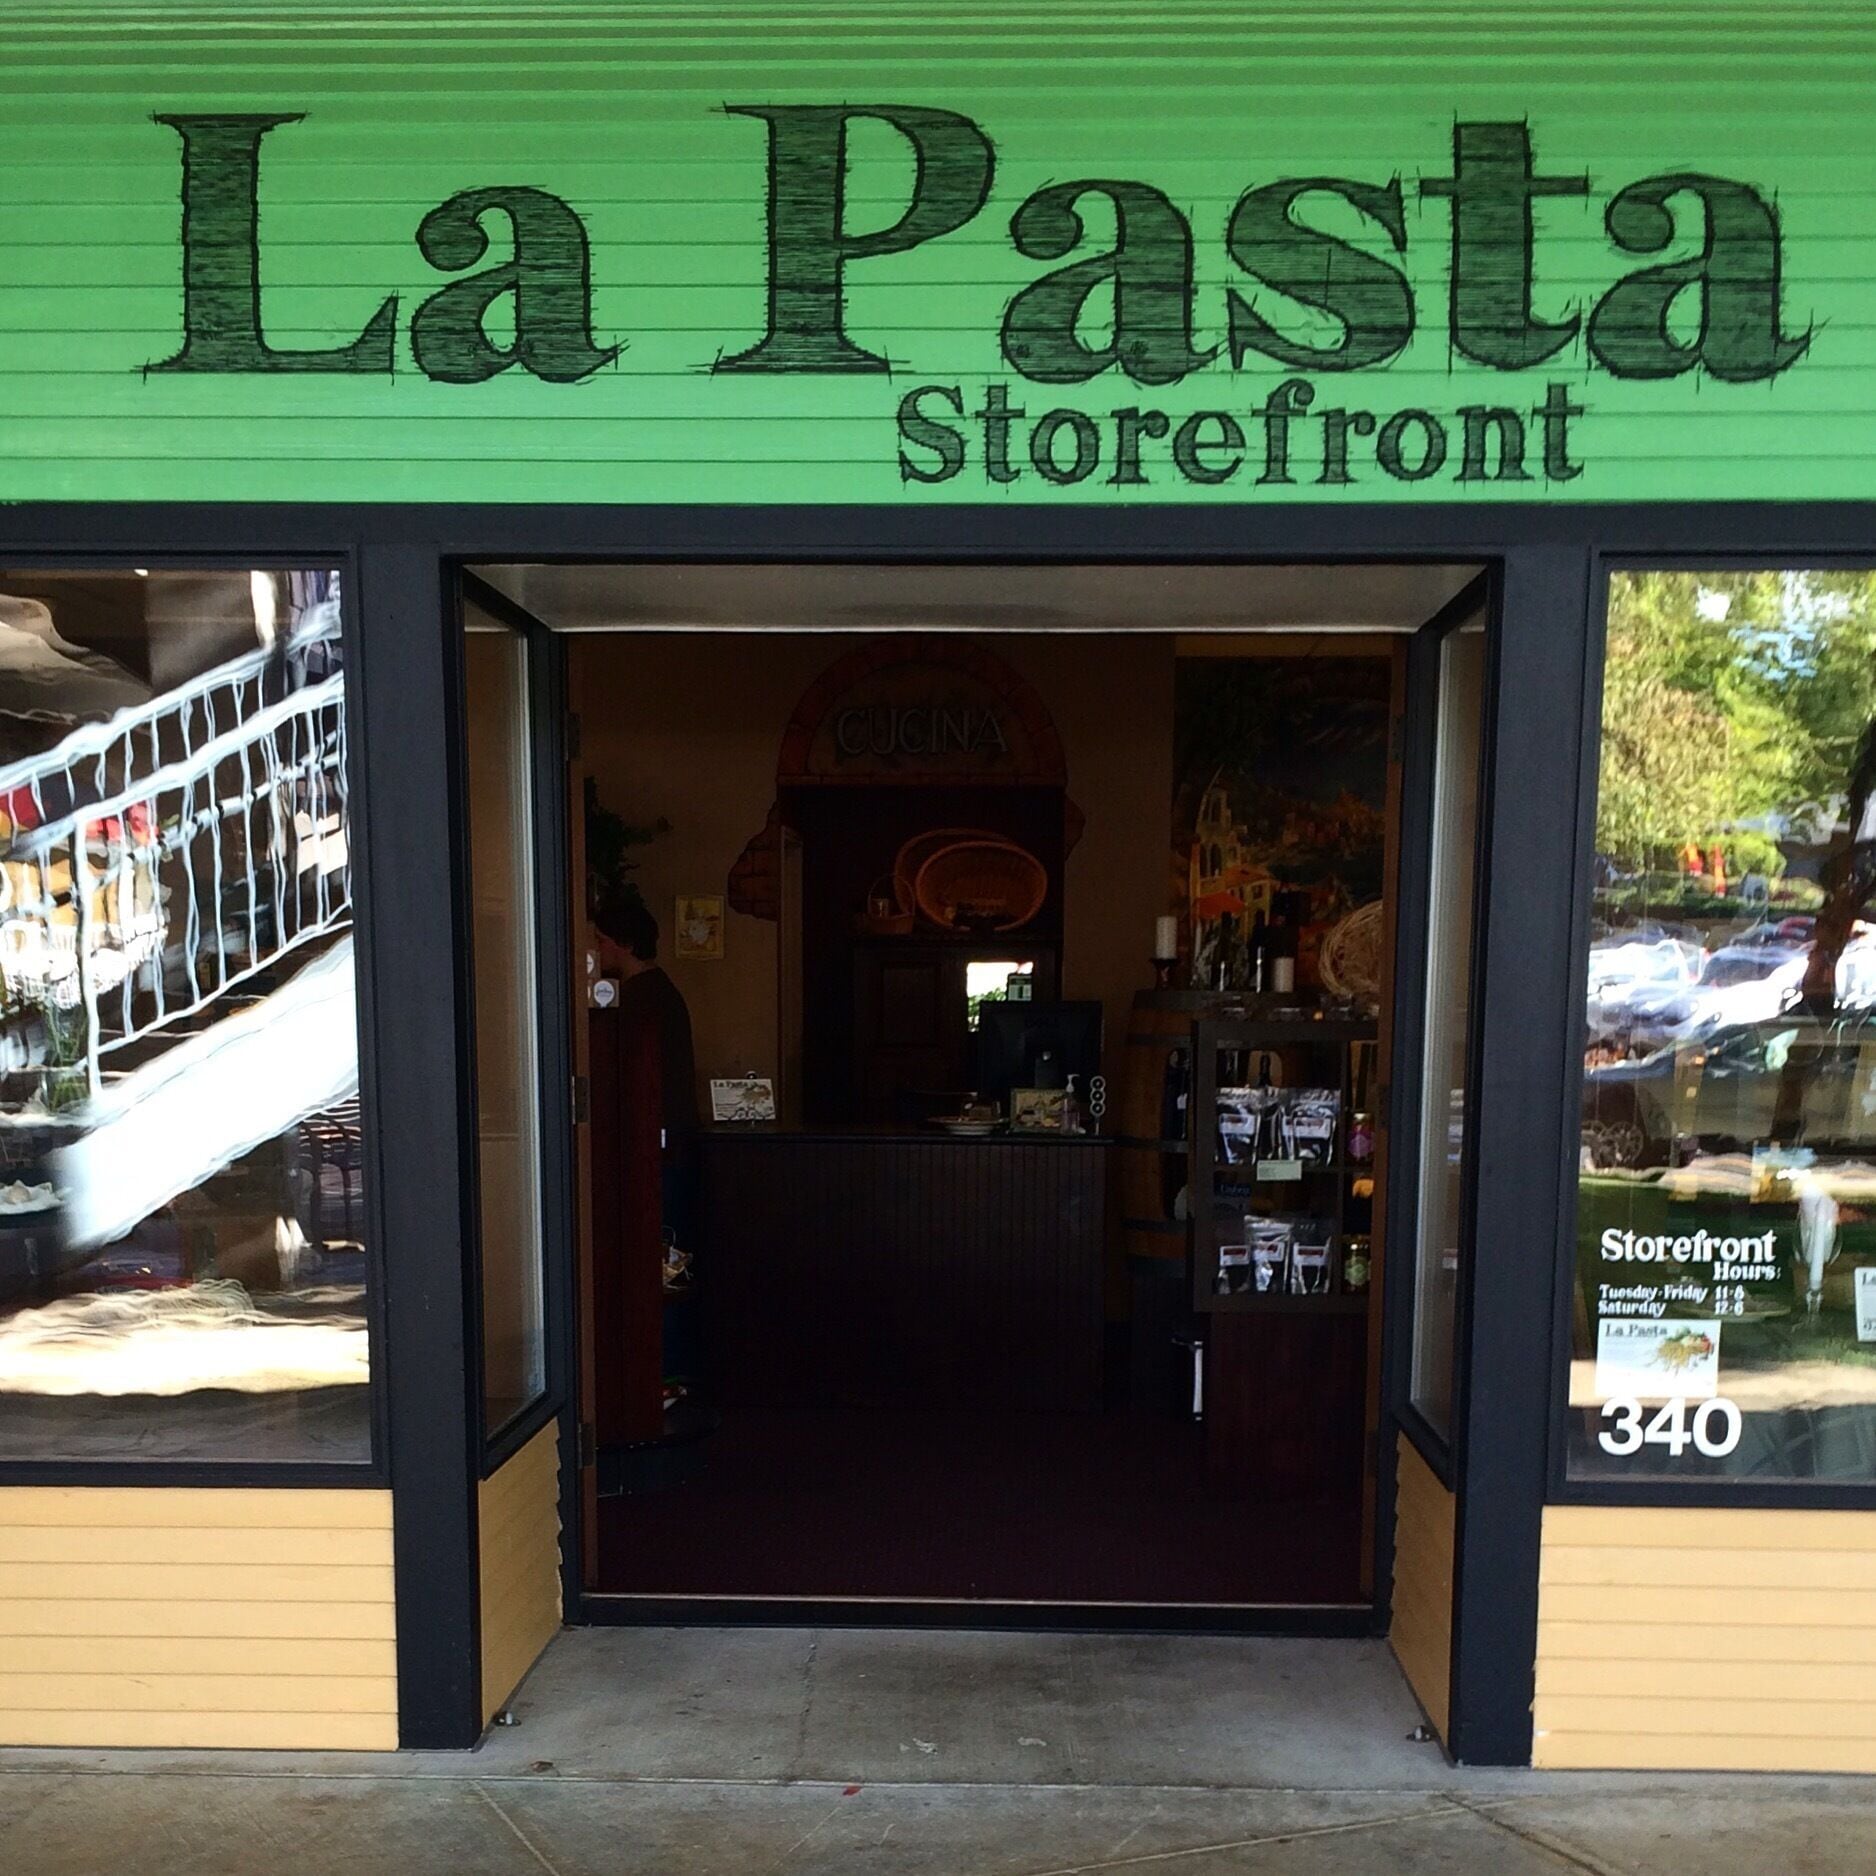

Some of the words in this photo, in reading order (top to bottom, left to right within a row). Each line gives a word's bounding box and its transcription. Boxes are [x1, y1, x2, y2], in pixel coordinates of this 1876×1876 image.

[136, 110, 628, 384] La
[704, 102, 1822, 385] Pasta
[898, 379, 1587, 486] Storefront
[836, 707, 1011, 757] CUCINA
[1601, 1229, 1778, 1263] Storefront
[1713, 1261, 1781, 1281] Hours:
[1598, 1300, 1667, 1318] Saturday
[1605, 1323, 1624, 1337] La
[1629, 1323, 1668, 1338] Pasta
[1597, 1396, 1742, 1458] 340
